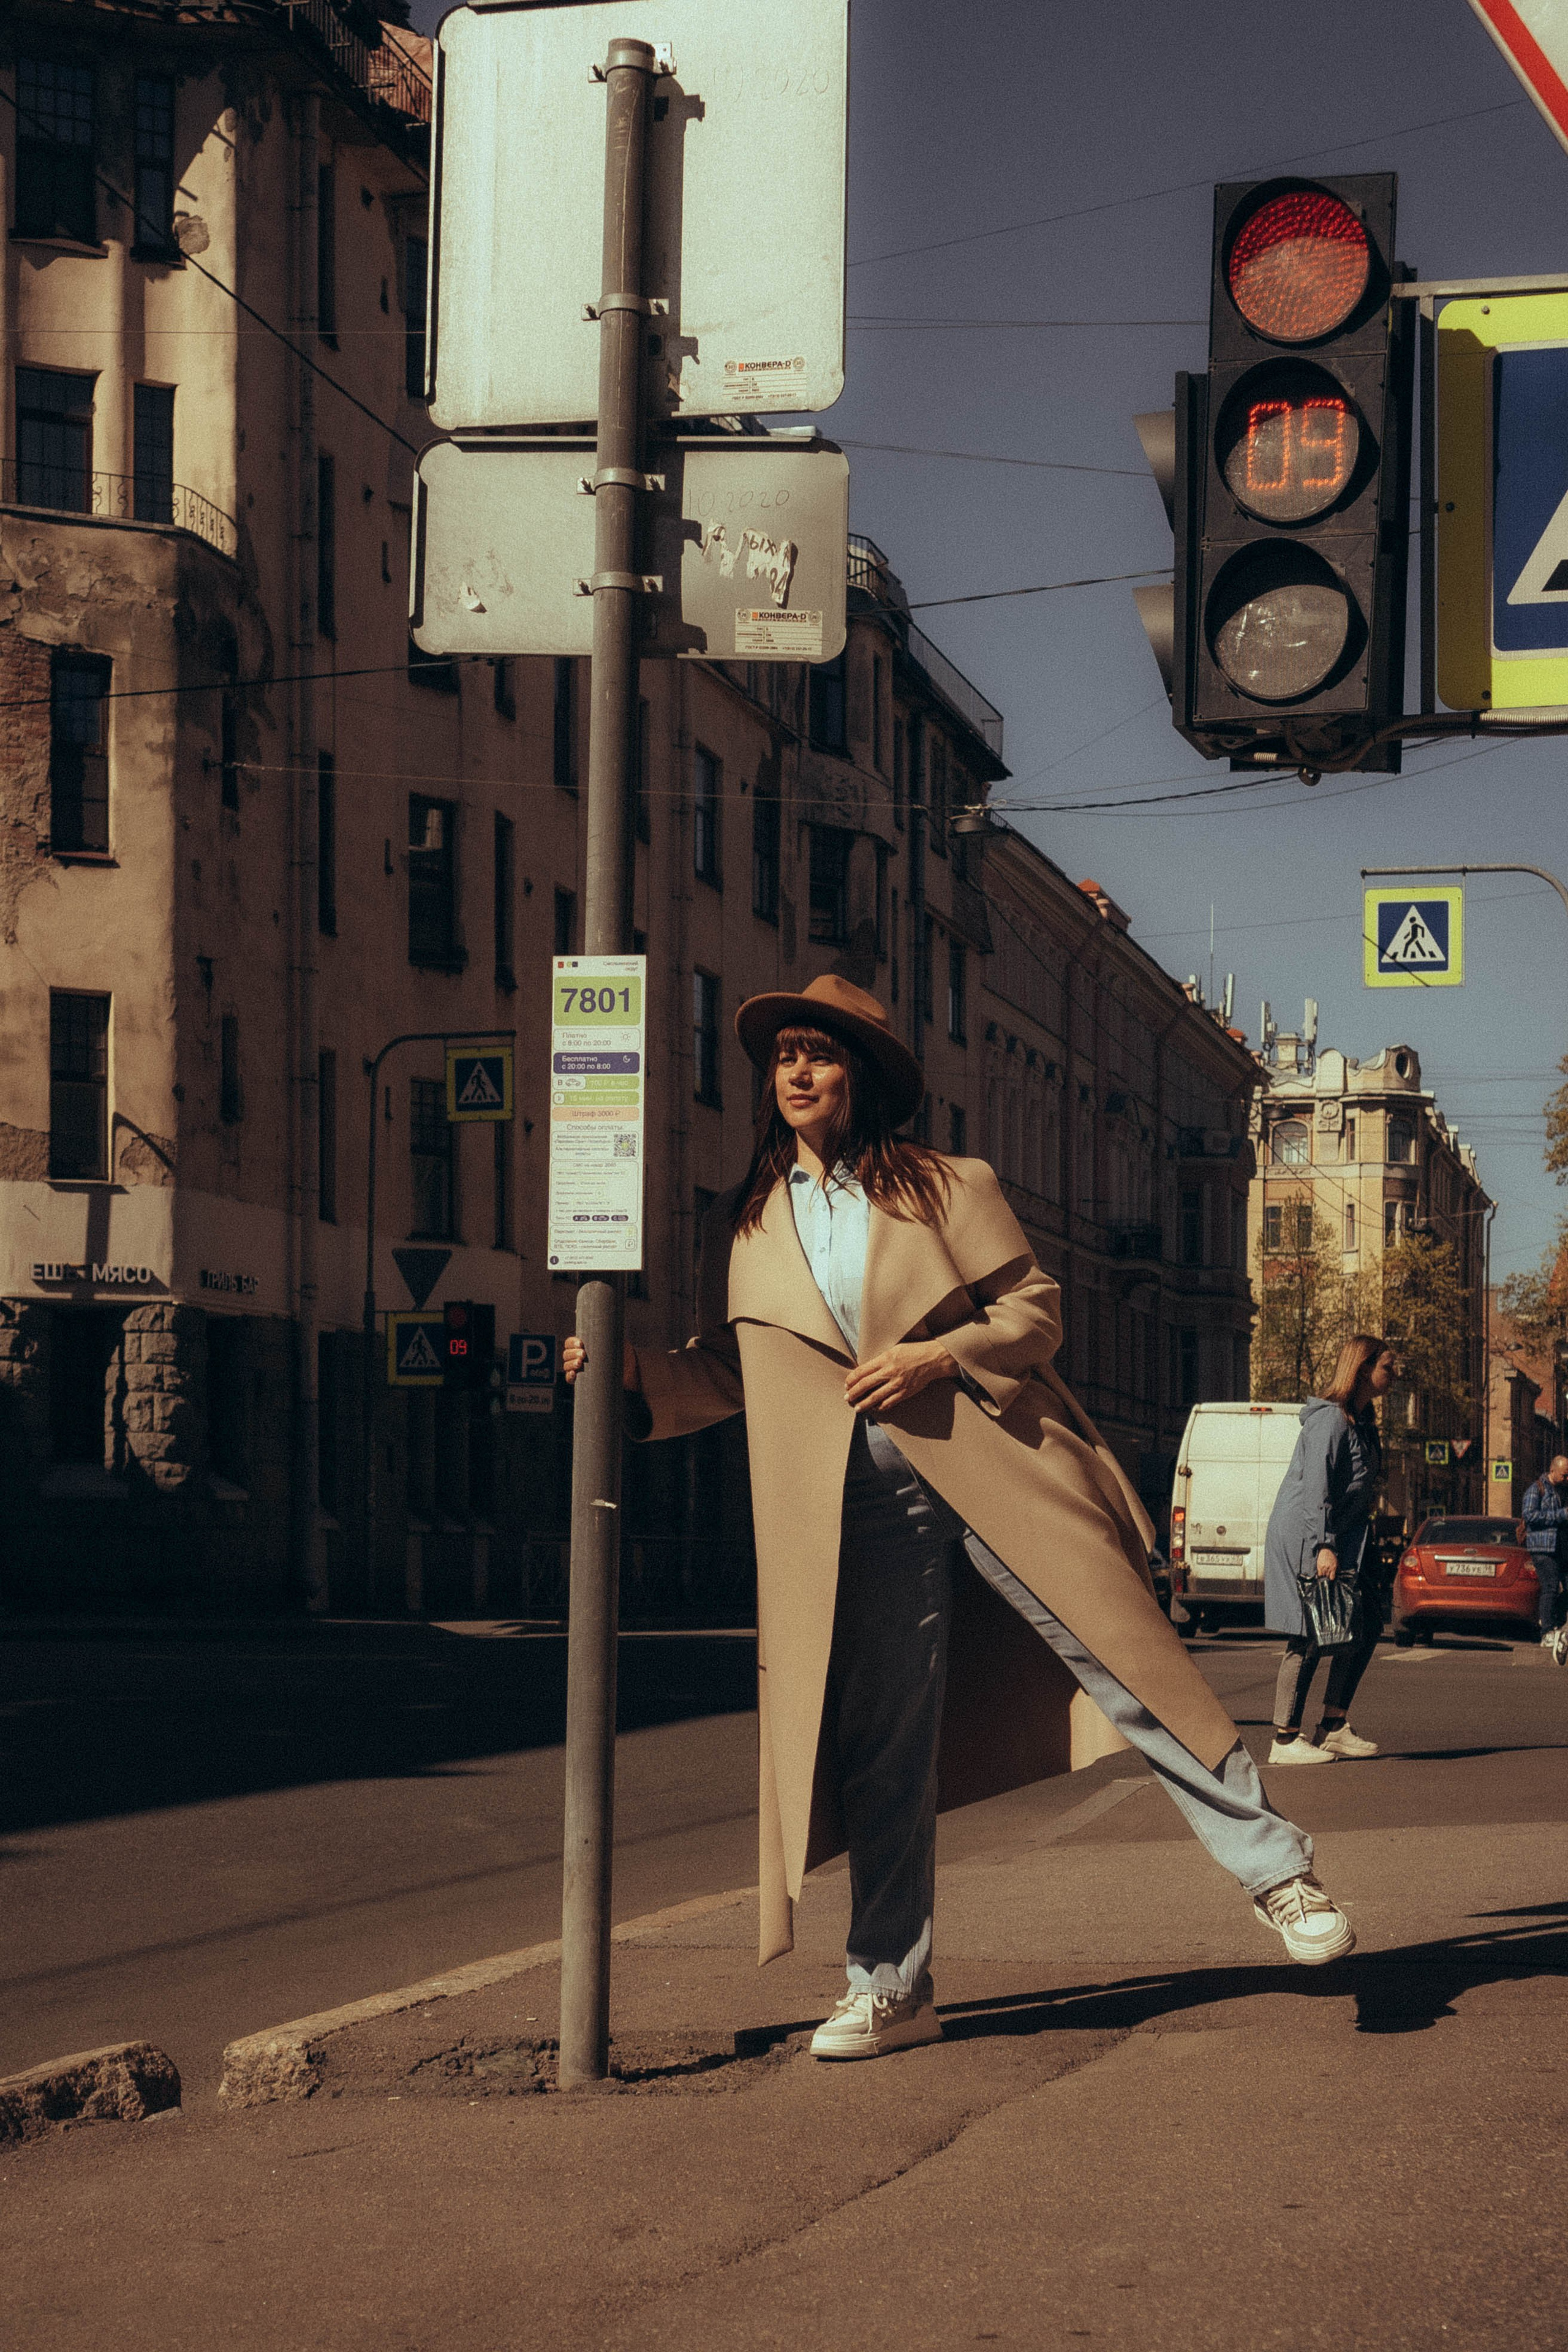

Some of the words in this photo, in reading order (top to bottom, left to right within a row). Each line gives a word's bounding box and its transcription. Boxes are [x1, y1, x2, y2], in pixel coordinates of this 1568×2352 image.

[1246, 398, 1345, 490] 09
[560, 987, 630, 1013] 7801
[92, 1263, 151, 1284] МЯСО
[450, 1339, 467, 1355] 09
